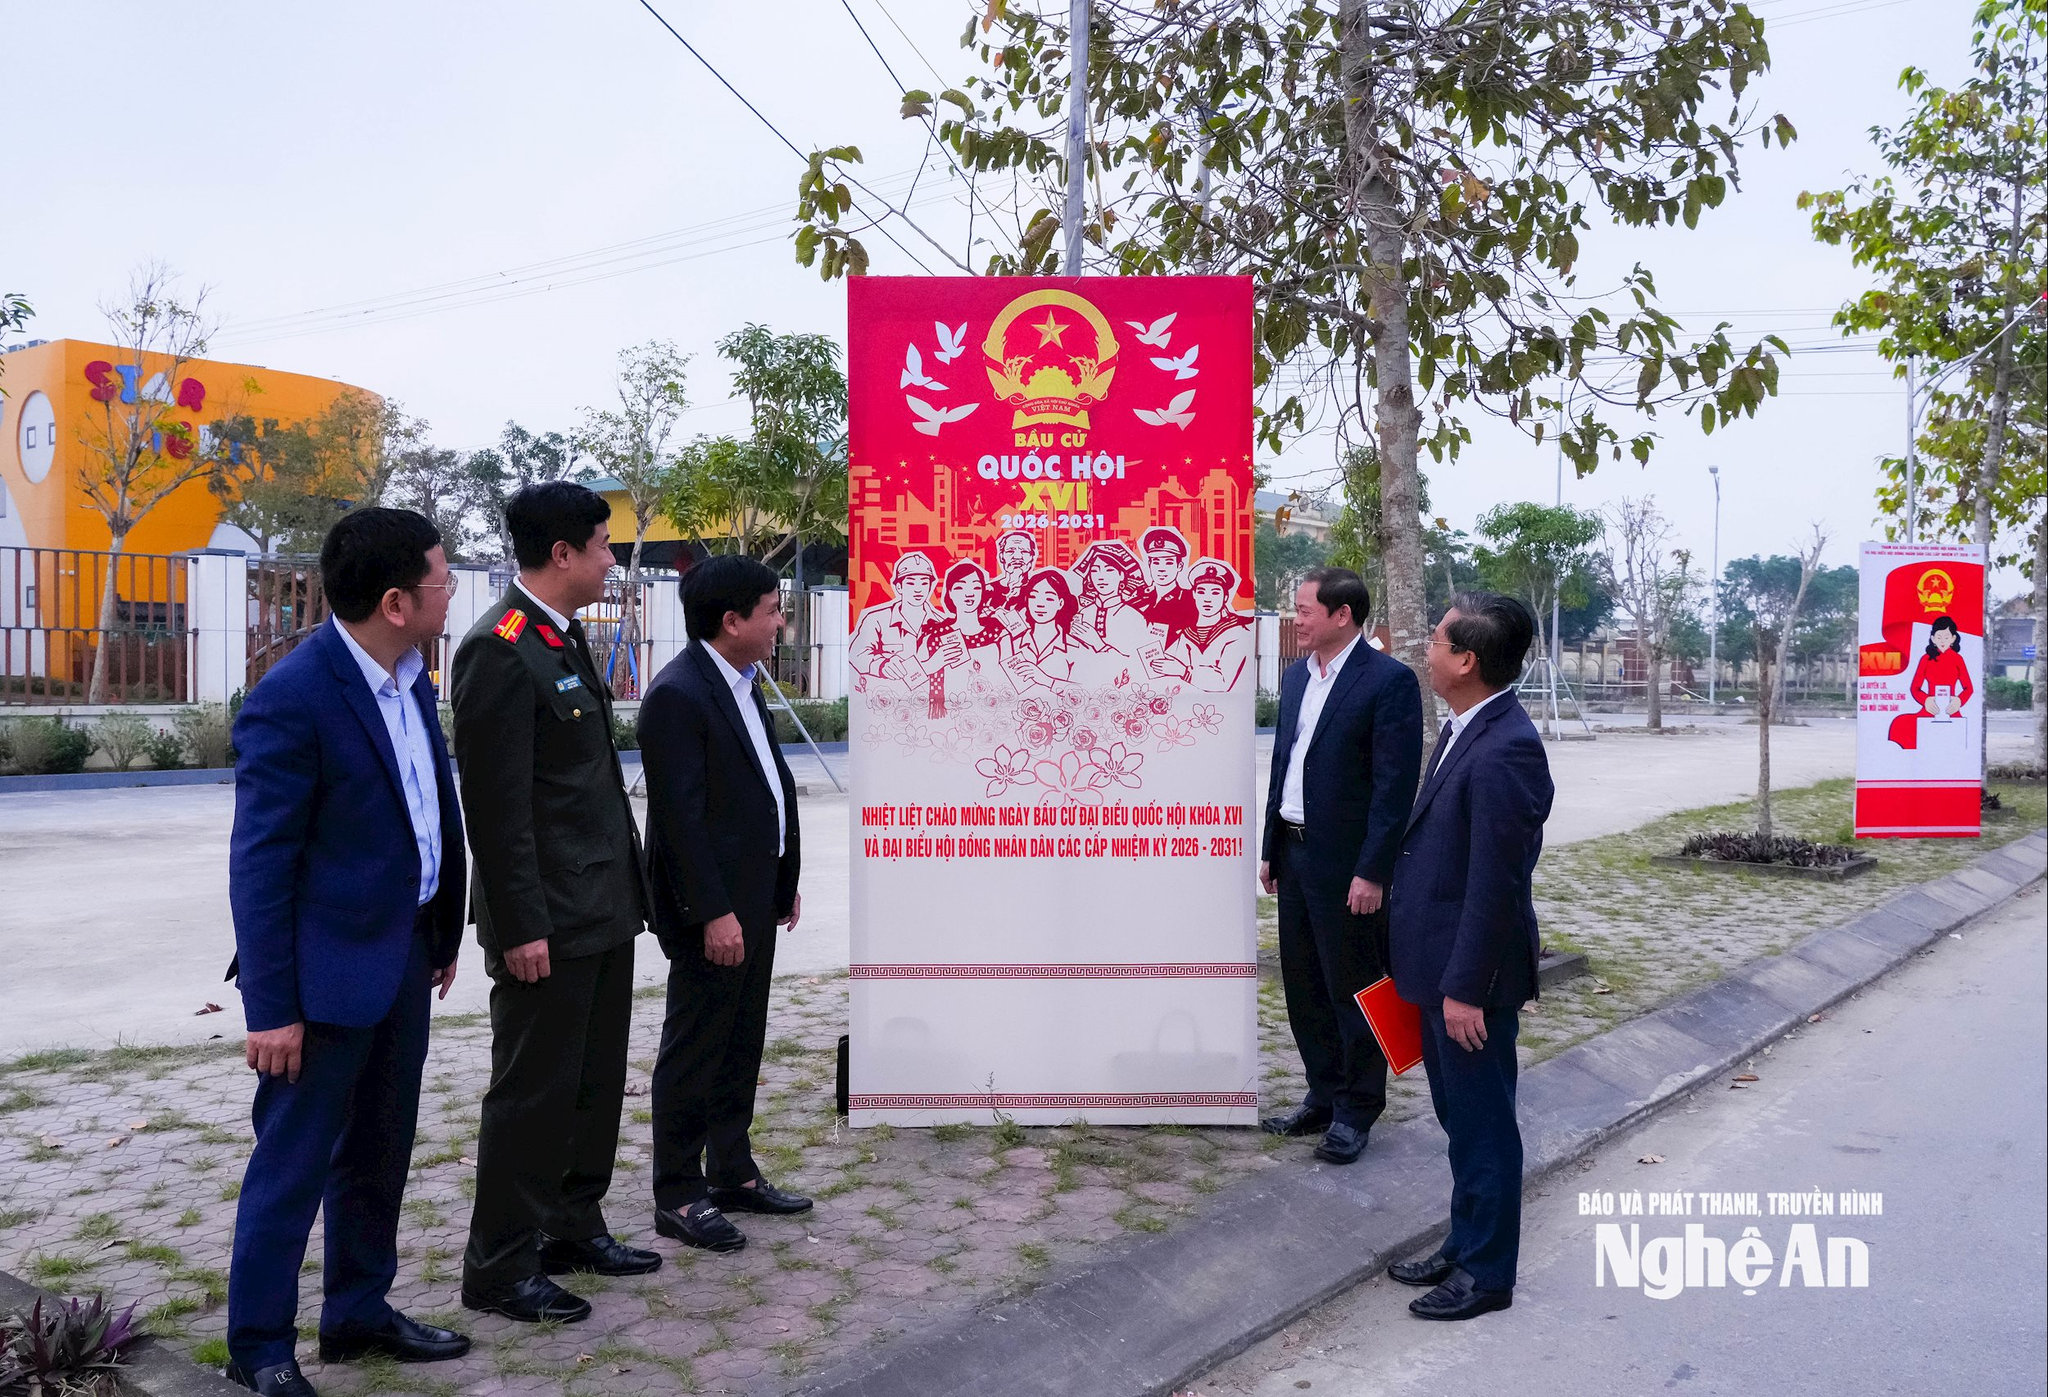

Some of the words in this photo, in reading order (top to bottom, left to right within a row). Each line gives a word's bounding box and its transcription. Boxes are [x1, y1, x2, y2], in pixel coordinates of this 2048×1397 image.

[85, 360, 206, 412] STAR
[1031, 404, 1050, 413] VIỆT
[1052, 404, 1071, 413] NAM
[1014, 429, 1054, 447] BẦU
[1060, 429, 1088, 447] CỬ
[977, 447, 1061, 480] QUỐC
[1071, 450, 1125, 486] HỘI
[1018, 482, 1088, 511] XVI
[1000, 514, 1105, 529] 2026-2031
[1860, 652, 1901, 670] XVI
[862, 802, 896, 830] NHIỆT
[899, 803, 923, 830] LIỆT
[926, 803, 957, 826] CHÀO
[961, 802, 995, 826] MỪNG
[999, 803, 1030, 826] NGÀY
[1033, 800, 1057, 826] BẦU
[1061, 799, 1077, 826] CỬ
[1079, 806, 1099, 830] ĐẠI
[1102, 799, 1129, 826] BIỂU
[1132, 800, 1163, 827] QUỐC
[1166, 802, 1186, 830] HỘI
[1189, 802, 1221, 825] KHÓA
[1224, 806, 1242, 825] XVI
[864, 834, 880, 858] VÀ
[883, 838, 902, 862] ĐẠI
[906, 830, 932, 858] BIỂU
[935, 834, 955, 862] HỘI
[958, 832, 991, 858] ĐỒNG
[994, 834, 1027, 858] NHÂN
[1030, 834, 1055, 858] DÂN
[1058, 834, 1081, 858] CÁC
[1084, 831, 1108, 858] CẤP
[1112, 834, 1149, 861] NHIỆM
[1153, 834, 1168, 857] KỲ
[1171, 837, 1199, 857] 2026
[1210, 837, 1243, 857] 2031!
